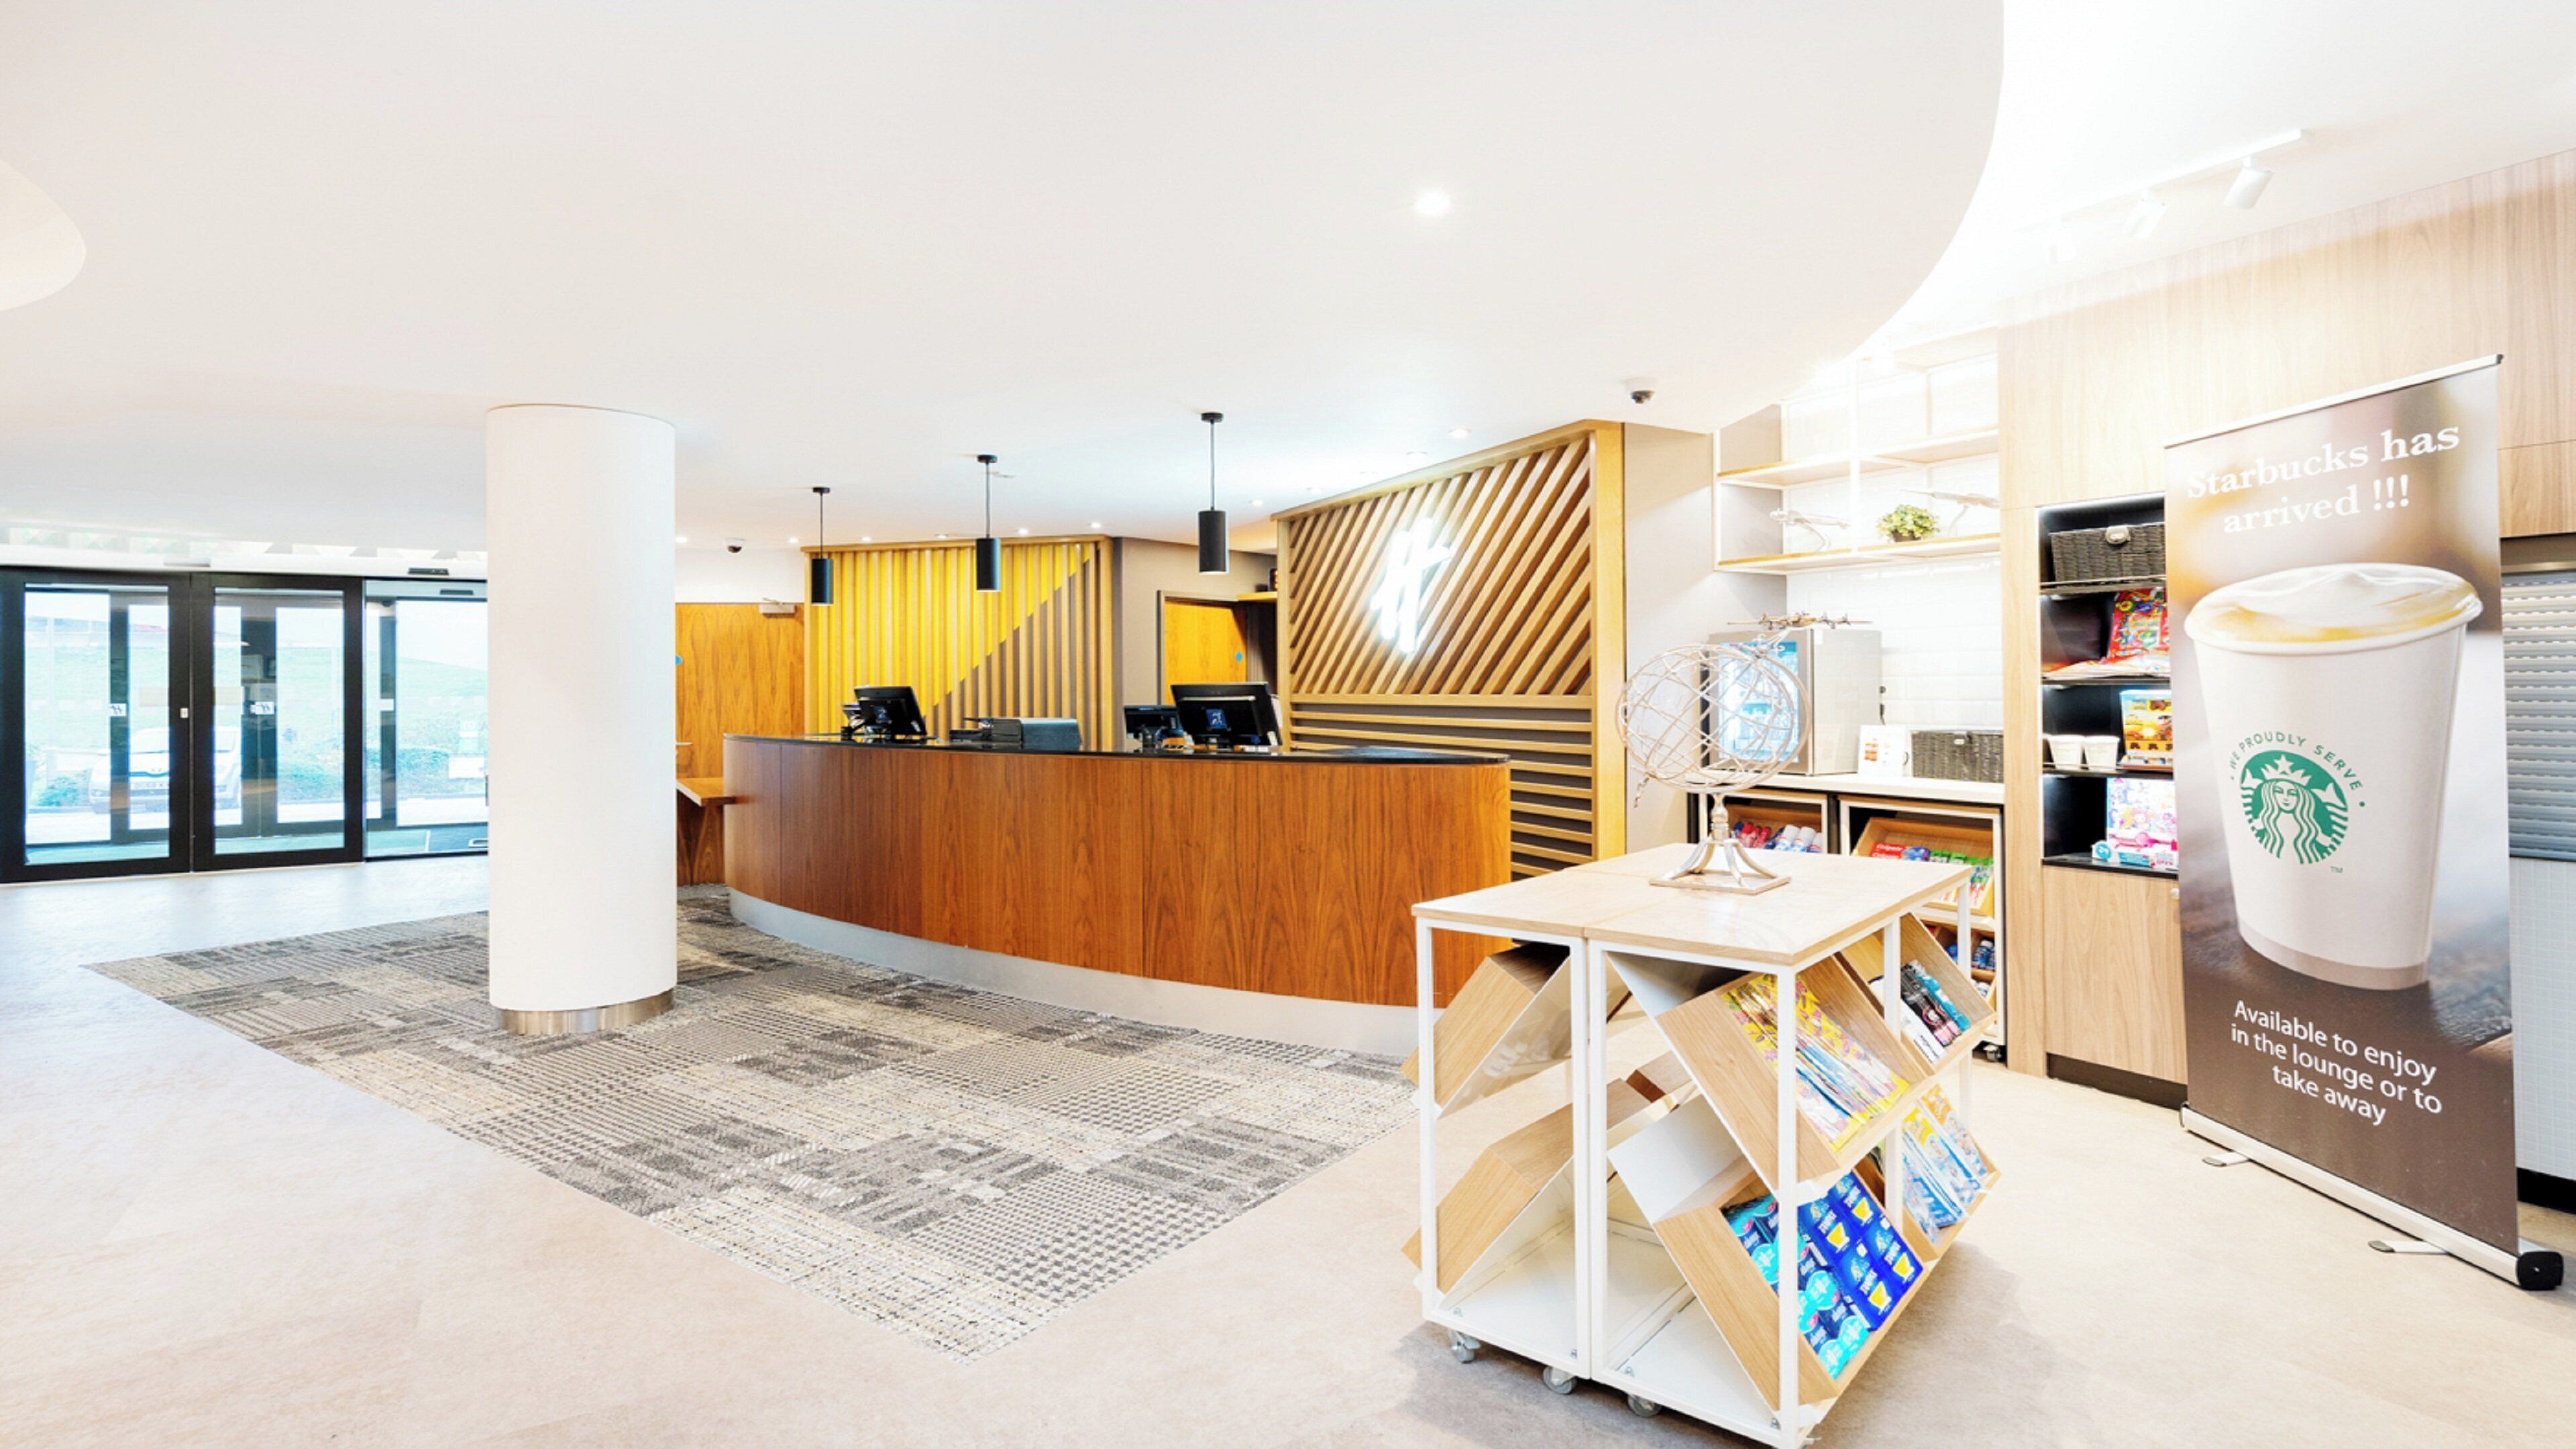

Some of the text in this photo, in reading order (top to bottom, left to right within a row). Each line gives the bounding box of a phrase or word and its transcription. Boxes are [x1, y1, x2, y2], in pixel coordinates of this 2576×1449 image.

[2187, 425, 2460, 499] Starbucks has
[2222, 474, 2410, 534] arrived !!!
[2239, 731, 2306, 753] PROUDLY
[2314, 744, 2363, 791] SERVE
[2231, 1022, 2443, 1114] in the lounge or to
[2234, 1000, 2437, 1086] Available to enjoy
[2272, 1065, 2387, 1126] take away
